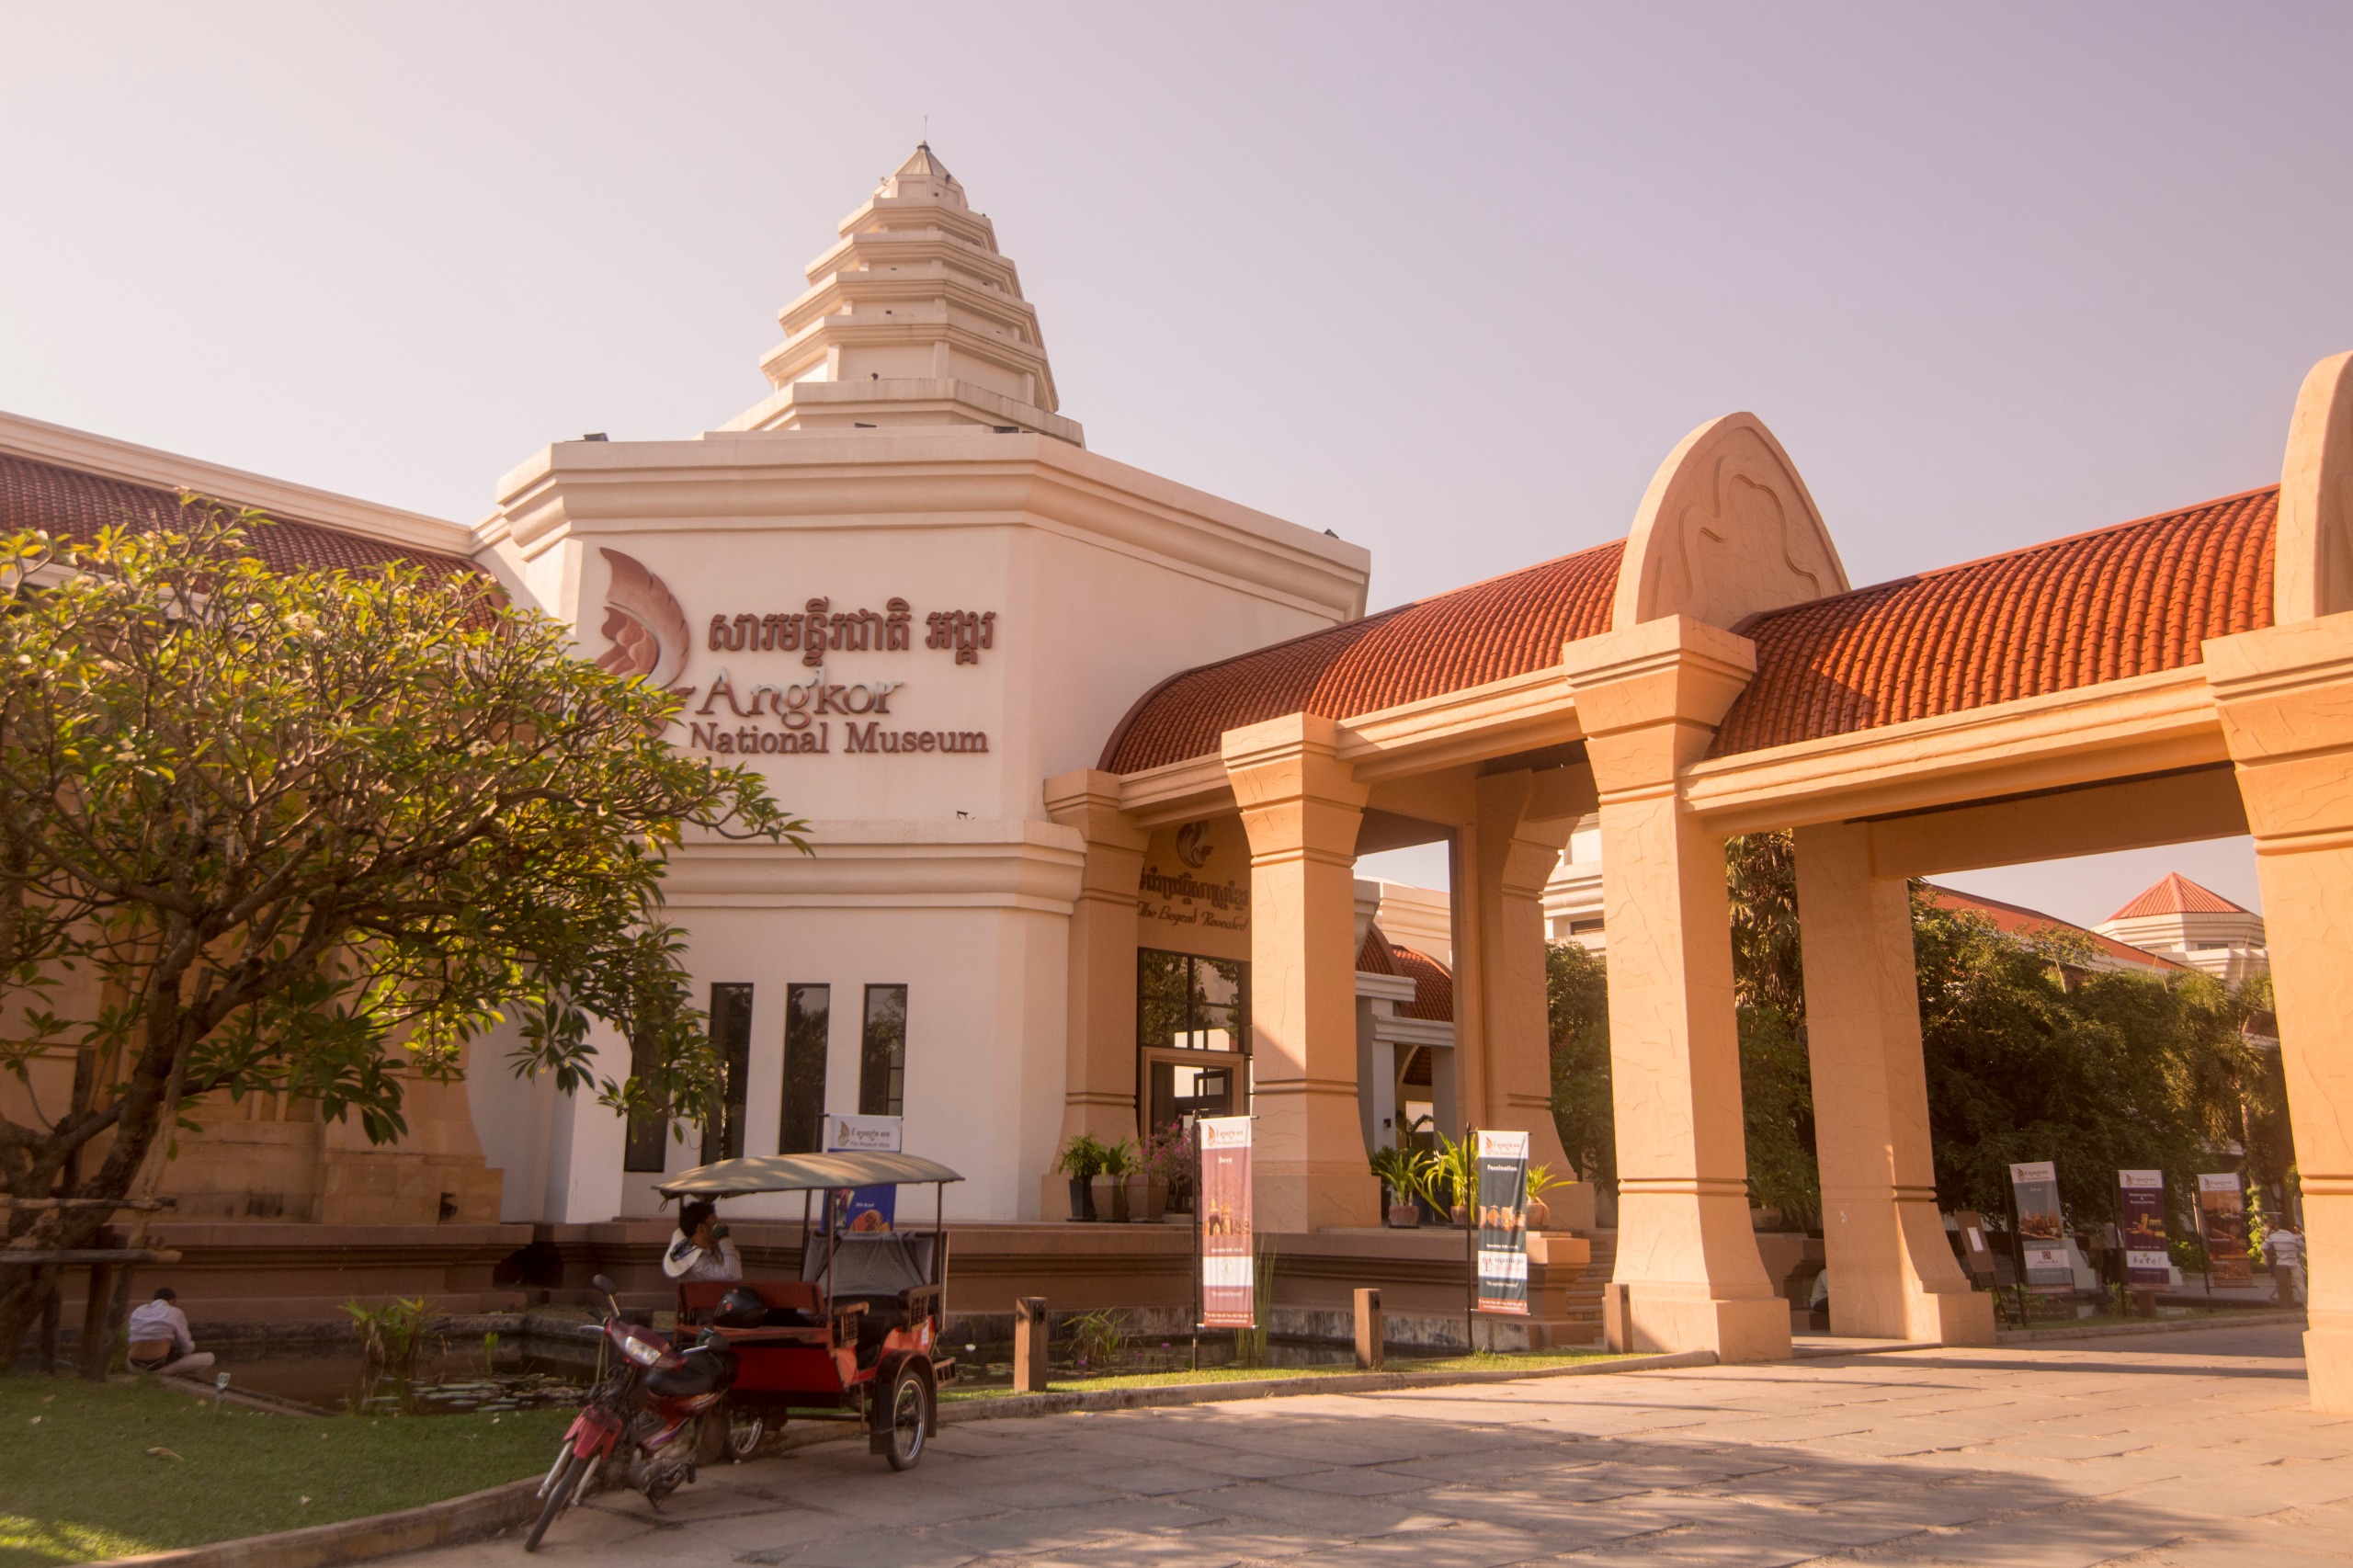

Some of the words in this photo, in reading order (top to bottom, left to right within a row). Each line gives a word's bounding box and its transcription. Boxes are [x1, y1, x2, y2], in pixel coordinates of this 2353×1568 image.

[925, 609, 997, 665] អង្គរ
[696, 665, 904, 730] Angkor
[690, 722, 829, 755] National
[844, 722, 989, 754] Museum
[1138, 901, 1157, 917] The
[1158, 904, 1198, 926] Legend
[1201, 911, 1249, 931] Revealed
[2132, 1255, 2162, 1265] betel
